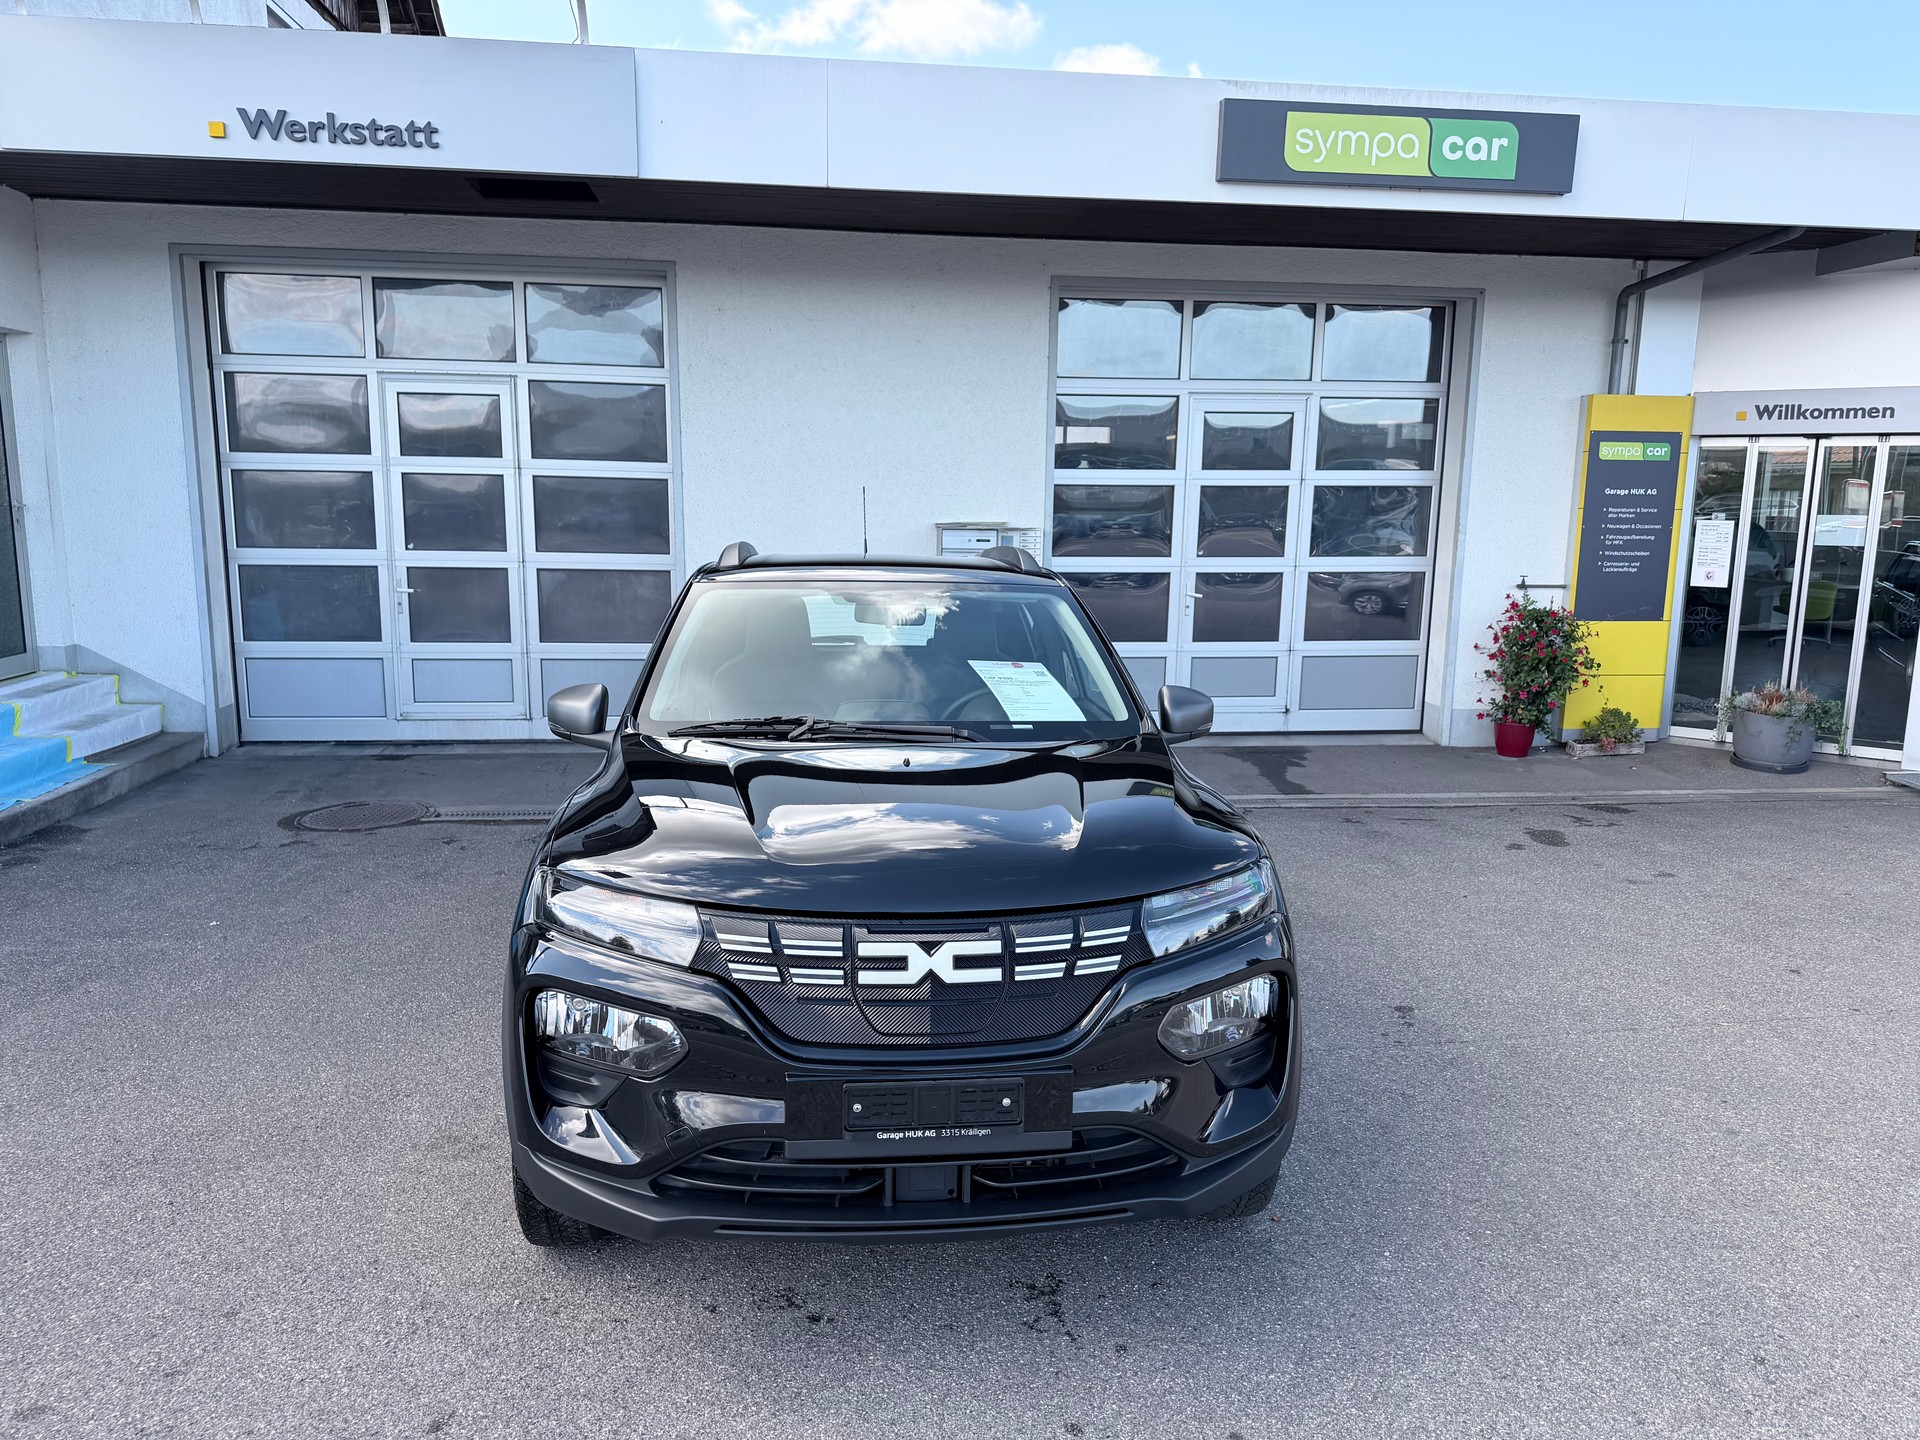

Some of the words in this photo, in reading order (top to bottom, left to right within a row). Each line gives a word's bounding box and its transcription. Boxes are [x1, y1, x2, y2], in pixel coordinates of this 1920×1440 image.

[235, 107, 440, 149] Werkstatt
[1294, 127, 1420, 166] sympa
[1441, 134, 1509, 162] car
[1754, 403, 1895, 421] Willkommen
[1601, 446, 1641, 458] sympa
[1646, 447, 1668, 456] car
[1604, 488, 1629, 496] Garage
[876, 1131, 904, 1140] Garage
[905, 1130, 924, 1138] HUK
[924, 1129, 936, 1137] AG
[941, 1128, 960, 1137] 3315
